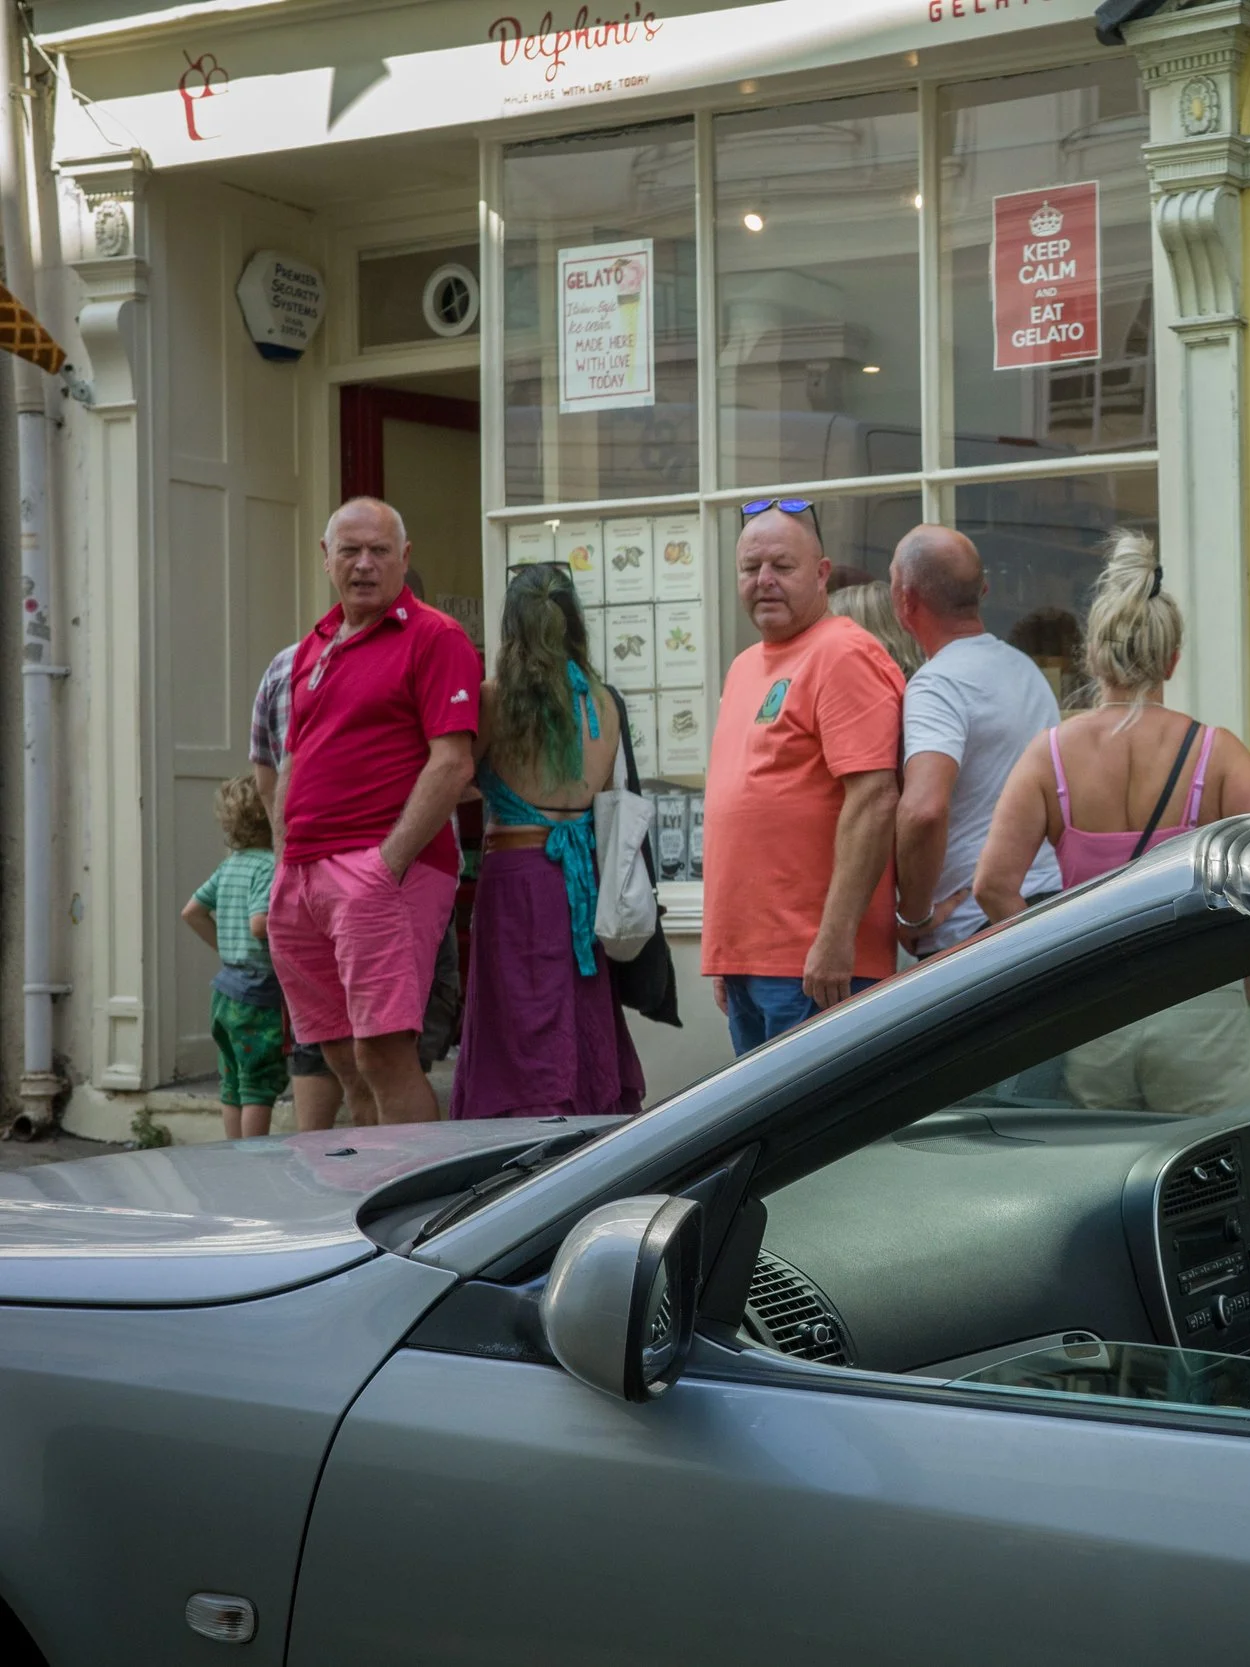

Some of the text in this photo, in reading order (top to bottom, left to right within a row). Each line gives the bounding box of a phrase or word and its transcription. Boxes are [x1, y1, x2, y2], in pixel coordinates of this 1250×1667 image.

[489, 1, 663, 82] Delphini's
[562, 85, 586, 96] WITH
[588, 80, 613, 92] LOVE
[1023, 239, 1071, 263] KEEP
[567, 265, 624, 290] GELATO
[1018, 260, 1076, 284] CALM
[1035, 286, 1057, 298] AND
[271, 294, 318, 319] SYSTEMS
[1030, 303, 1064, 324] EAT
[575, 334, 635, 353] MADE HERE
[1012, 323, 1084, 348] GELATO
[576, 354, 631, 372] WITH LOVE
[588, 373, 625, 390] TODAY
